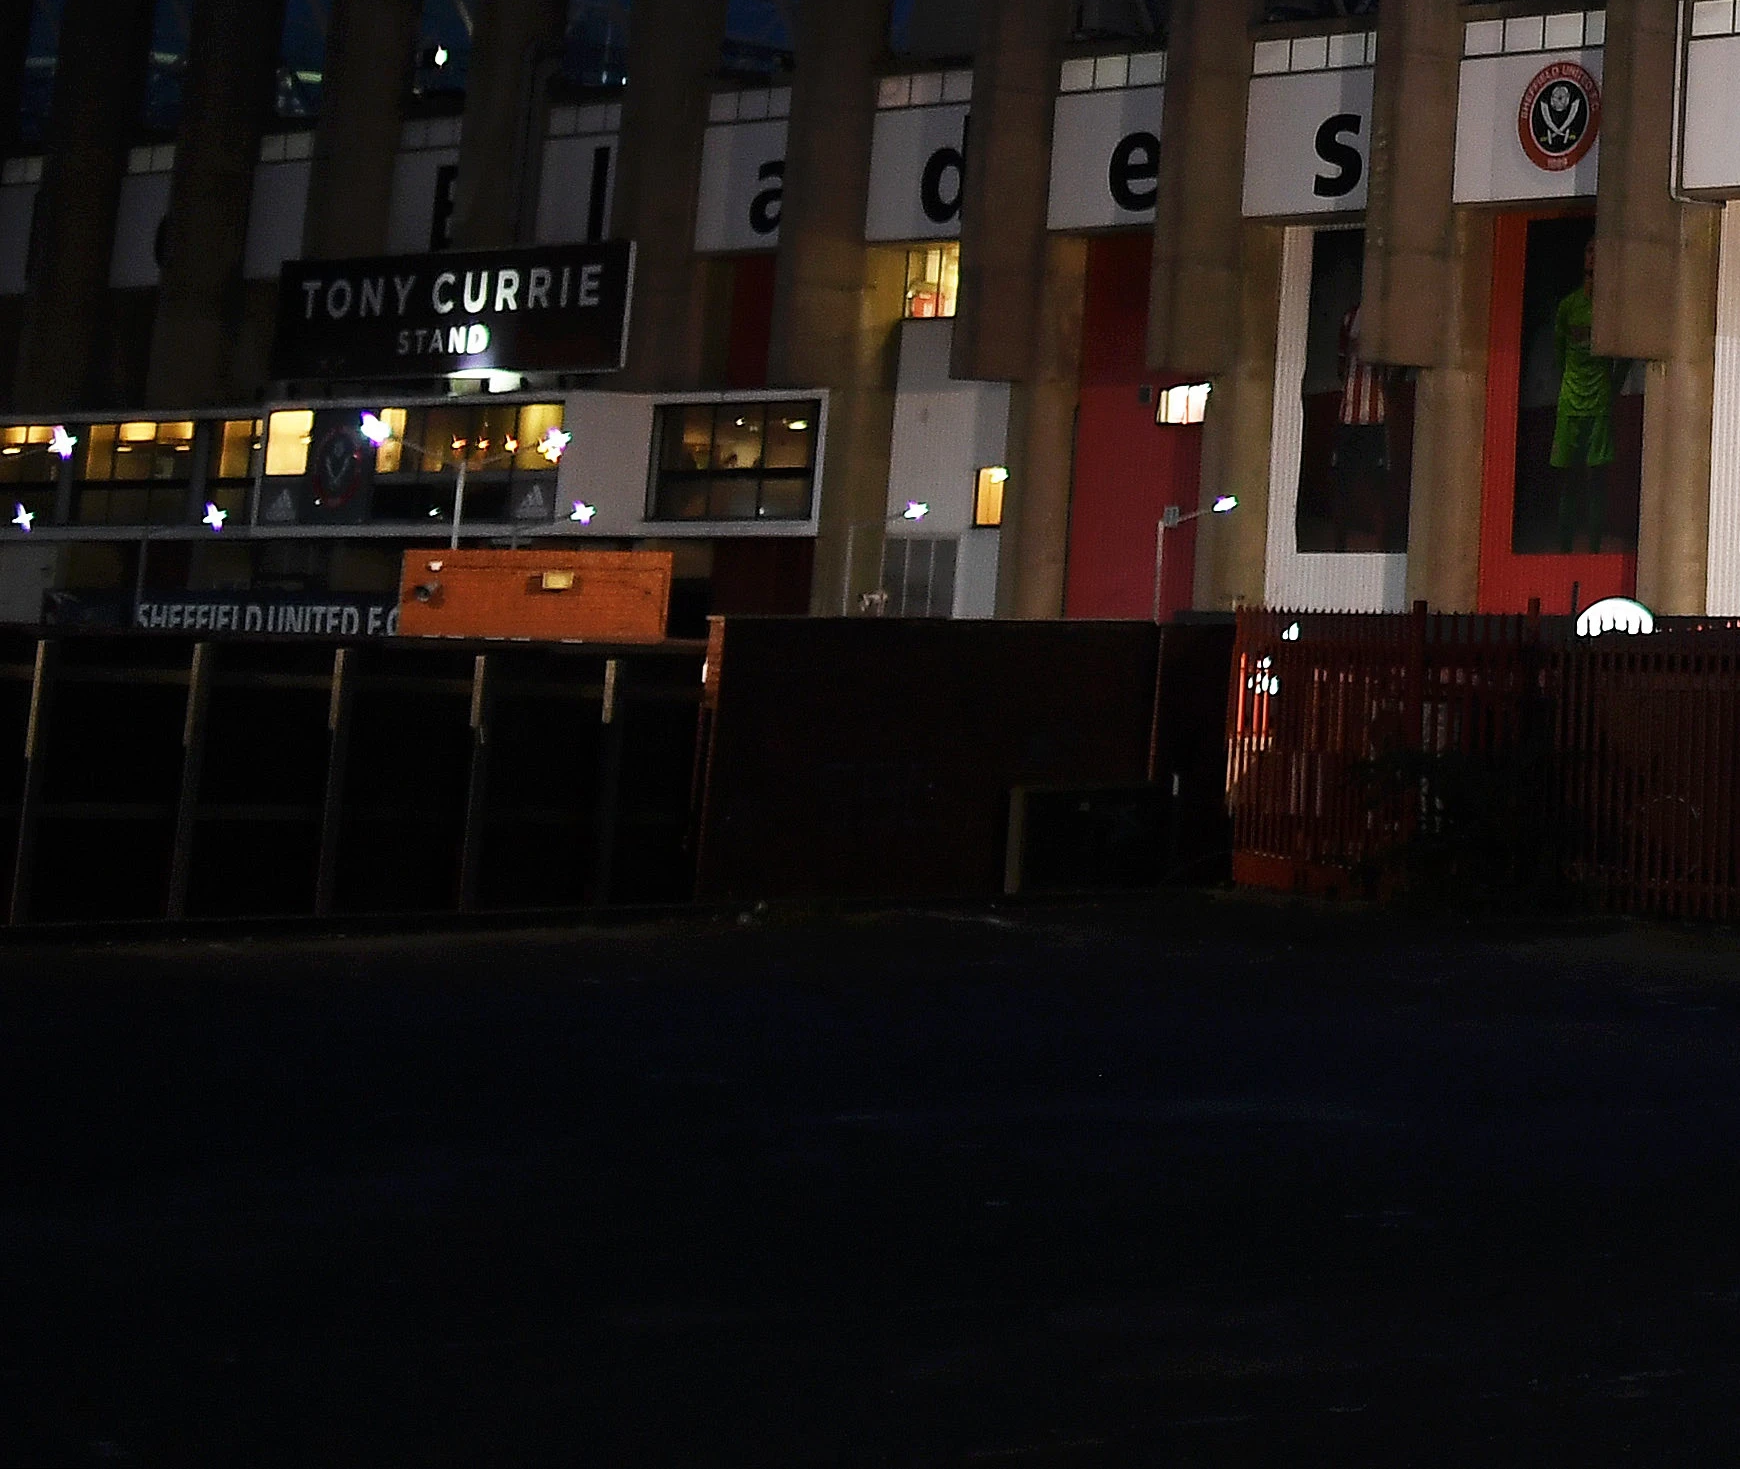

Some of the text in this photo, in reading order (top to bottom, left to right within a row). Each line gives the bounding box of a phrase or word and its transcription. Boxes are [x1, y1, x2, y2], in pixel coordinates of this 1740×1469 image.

[301, 263, 603, 320] TONY CURRIE
[396, 322, 491, 355] STAND
[267, 606, 360, 635] UNITED
